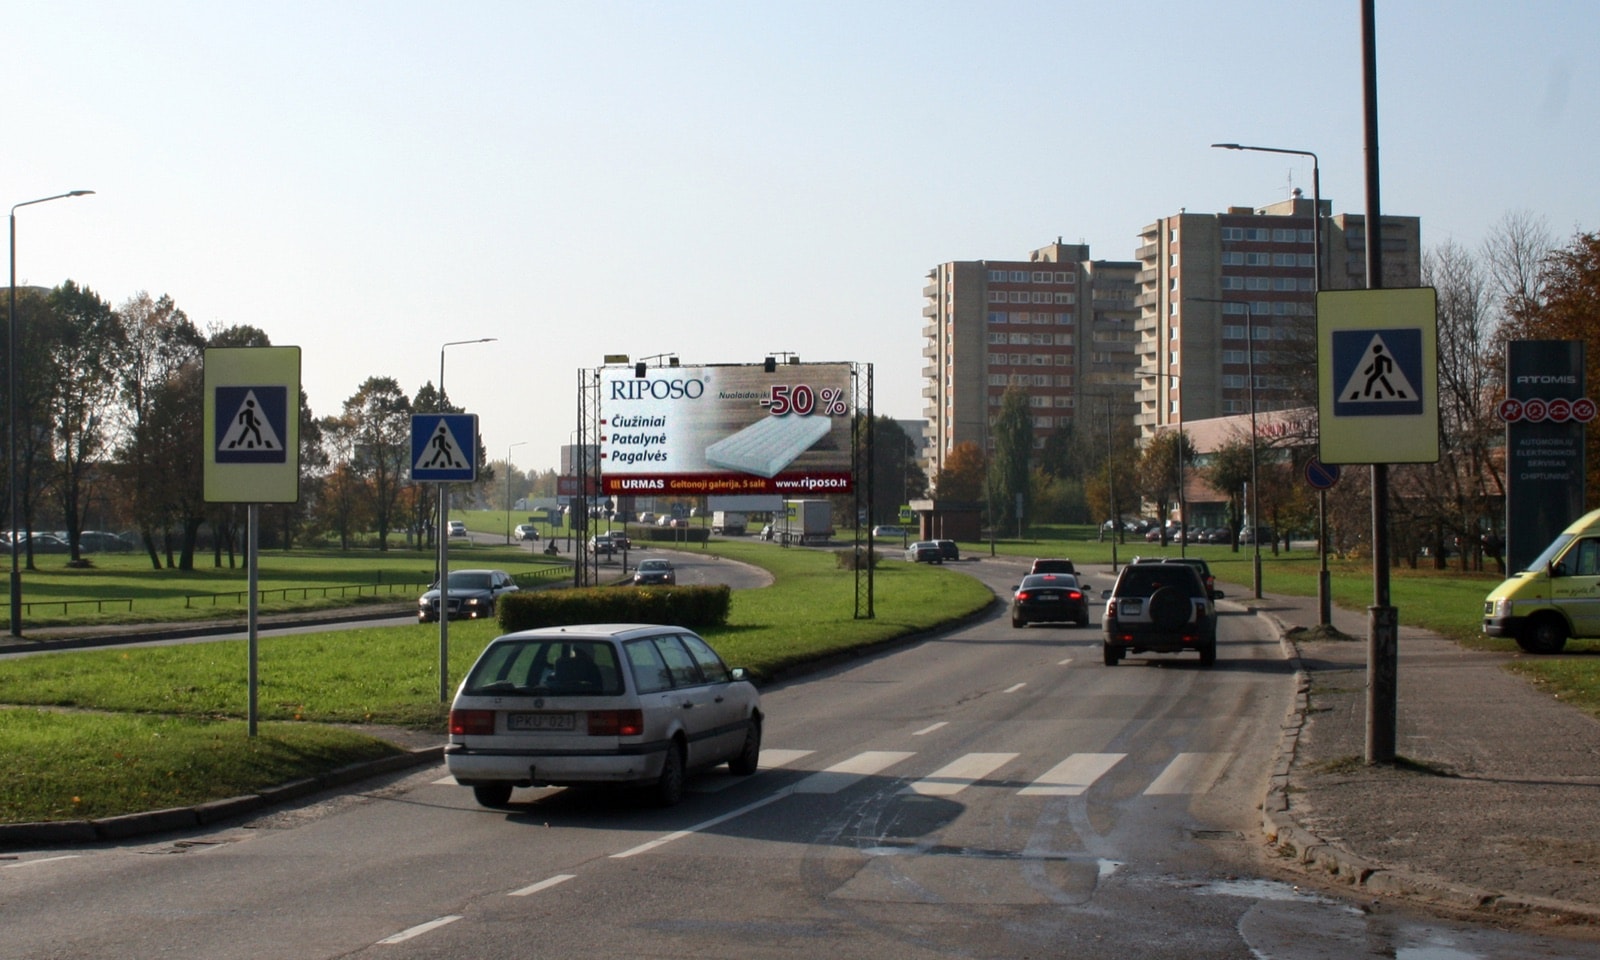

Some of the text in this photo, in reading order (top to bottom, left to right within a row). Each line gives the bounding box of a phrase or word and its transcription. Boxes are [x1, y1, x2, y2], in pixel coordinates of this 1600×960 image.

[611, 379, 704, 400] RIPOSO
[611, 414, 666, 428] Čiužiniai
[611, 432, 667, 447] Patalynė
[611, 449, 668, 465] Pagalvės
[621, 479, 664, 489] URMAS
[670, 479, 707, 490] Geltonoji
[776, 477, 847, 490] www.riposo.lt
